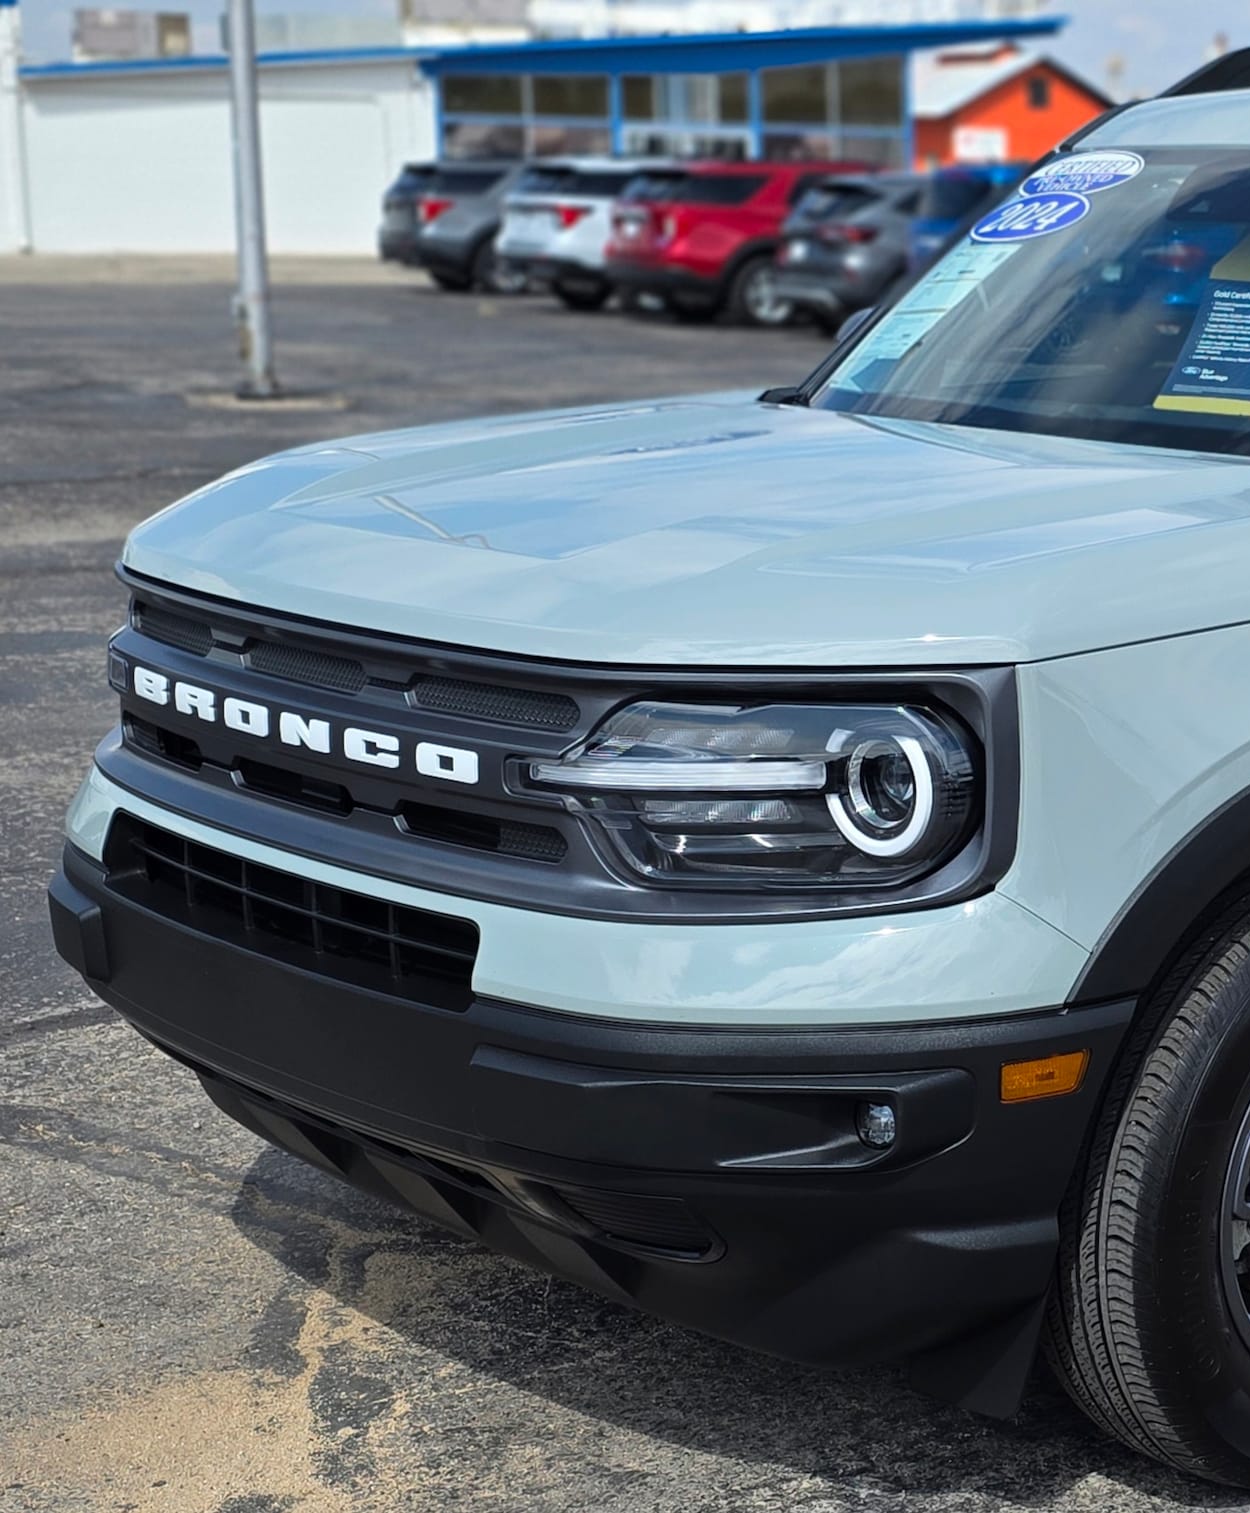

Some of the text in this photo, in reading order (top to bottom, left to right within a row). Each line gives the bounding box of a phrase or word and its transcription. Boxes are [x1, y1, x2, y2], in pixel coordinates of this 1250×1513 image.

[1045, 159, 1136, 175] CERTIFIED
[1035, 182, 1091, 192] VEHICLE
[978, 200, 1081, 234] 2024
[1213, 290, 1231, 299] Gold
[133, 666, 479, 784] BRONCO
